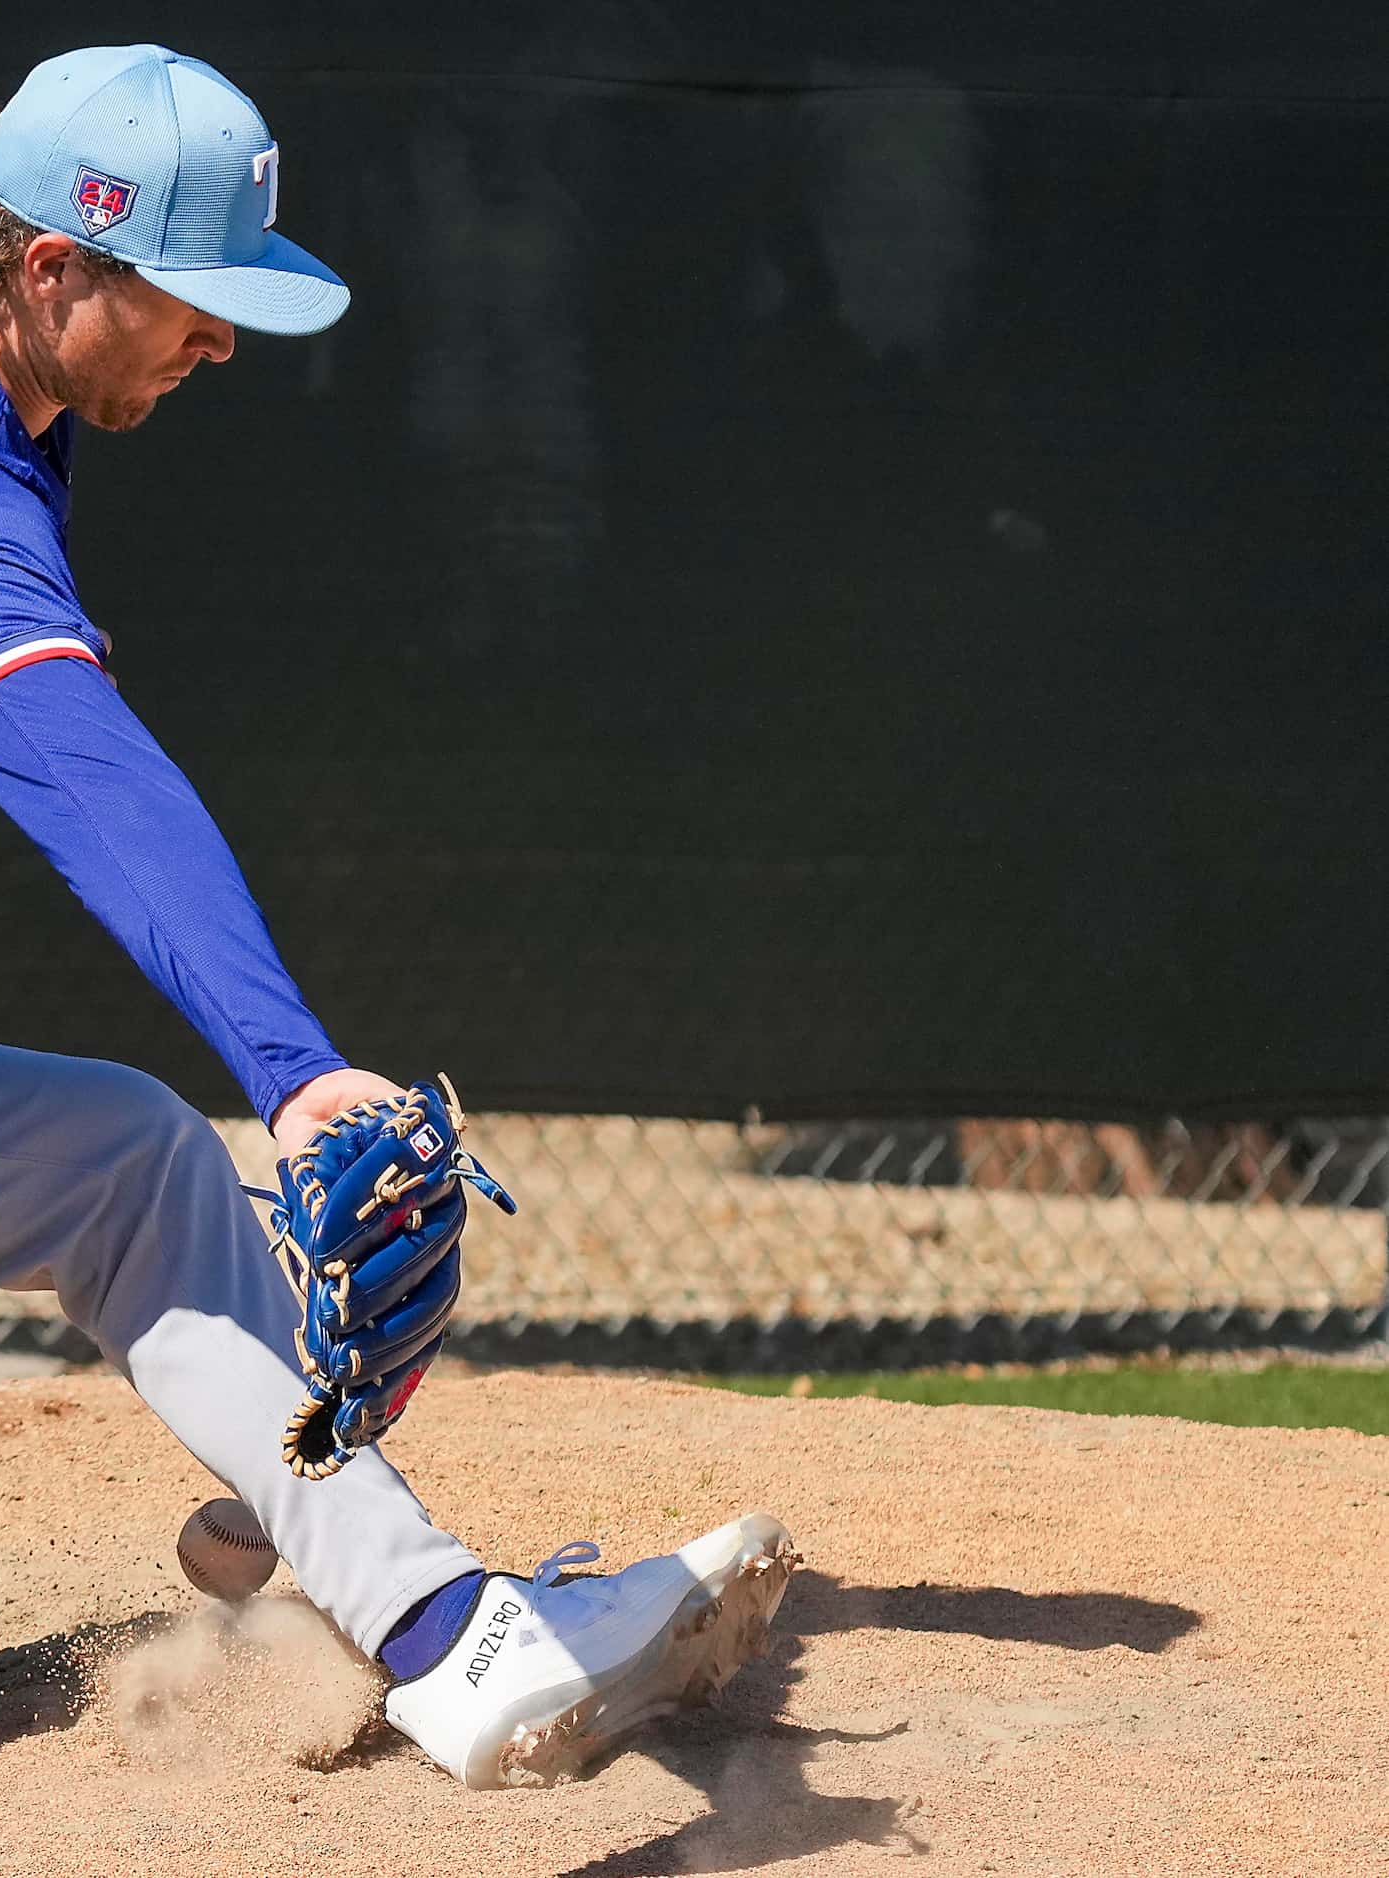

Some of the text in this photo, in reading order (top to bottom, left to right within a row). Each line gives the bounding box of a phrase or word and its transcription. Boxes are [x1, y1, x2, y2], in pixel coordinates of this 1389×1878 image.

[80, 181, 125, 216] 24
[253, 141, 279, 231] T
[466, 1600, 522, 1689] ADIZERO
